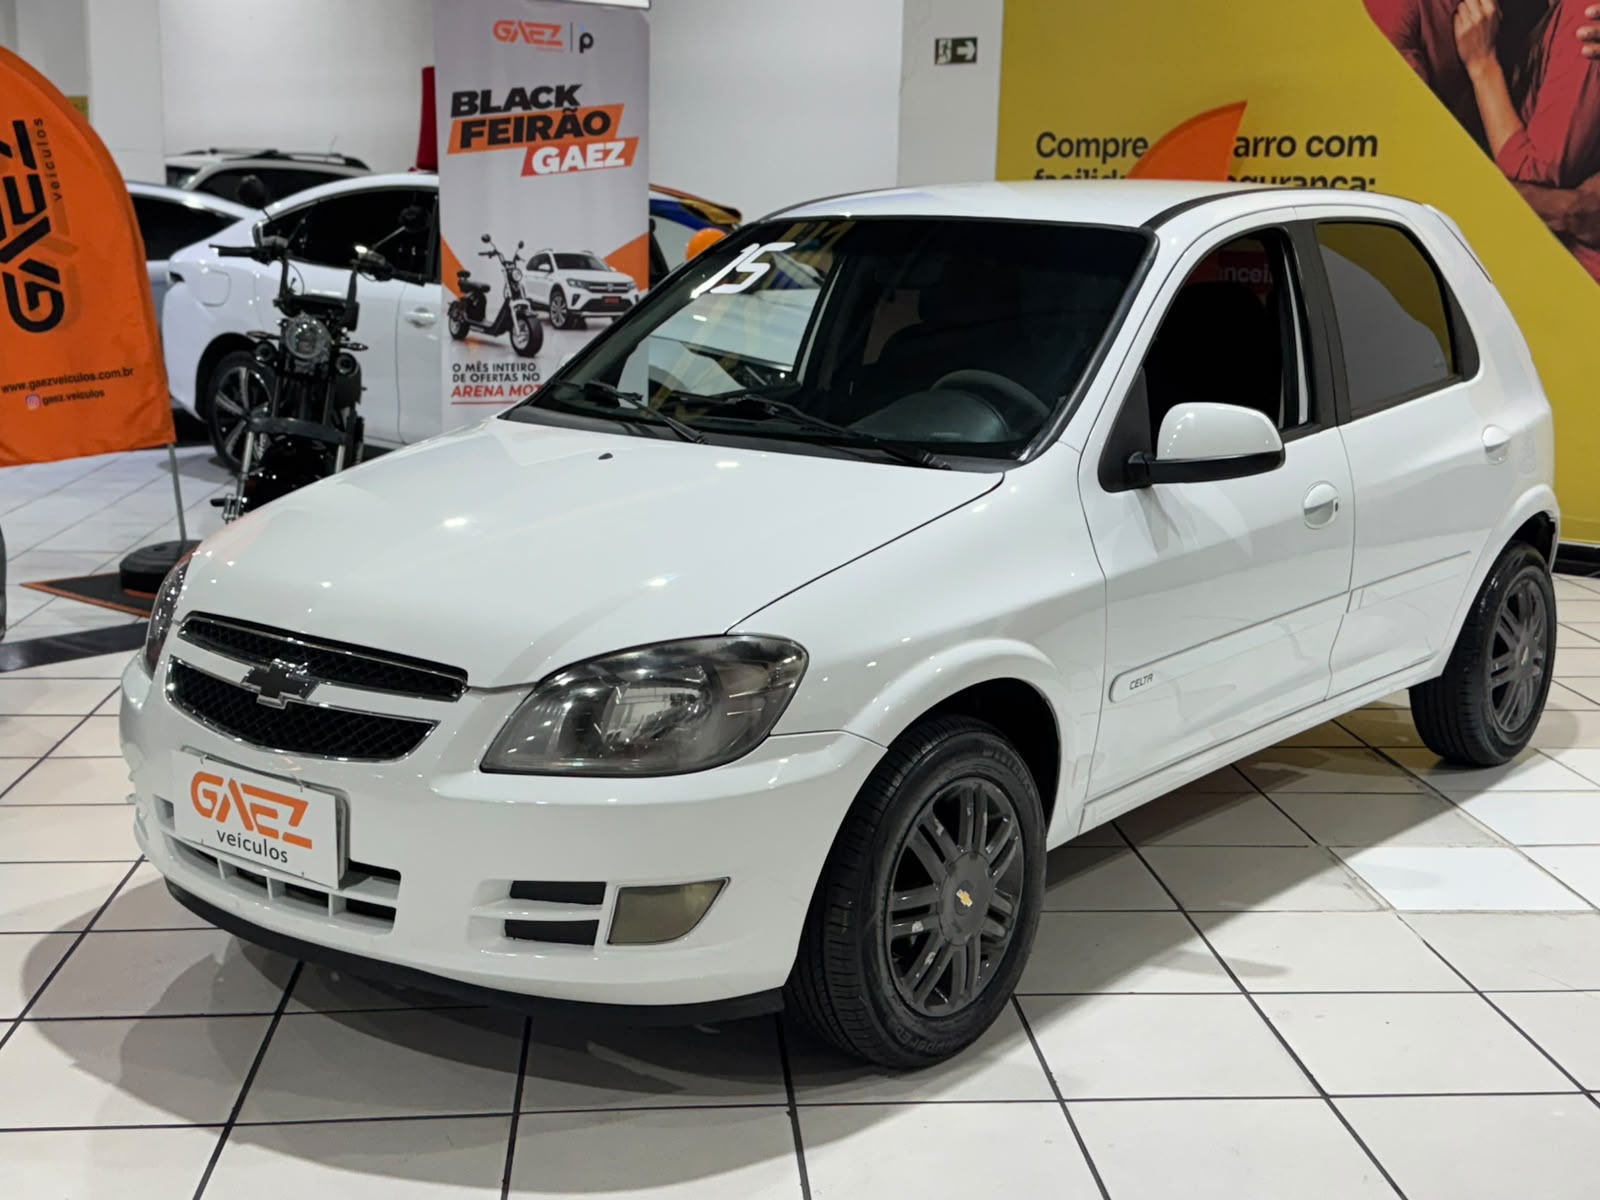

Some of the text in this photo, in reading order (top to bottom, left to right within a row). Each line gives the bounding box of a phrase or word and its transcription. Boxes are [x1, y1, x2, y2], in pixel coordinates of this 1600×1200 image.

[493, 20, 563, 47] GAEZ
[451, 84, 582, 118] BLACK
[460, 108, 611, 149] FEIRÃO
[531, 141, 626, 175] GAEZ
[1036, 131, 1378, 164] Compre arro com
[689, 242, 797, 299] 15
[1, 366, 134, 393] www.gaezveiculos.com.br
[452, 361, 537, 373] O MÊS INTEIRO
[452, 372, 541, 383] DE OFERTAS NO
[451, 385, 505, 398] ARENA
[190, 771, 313, 850] GAEZ
